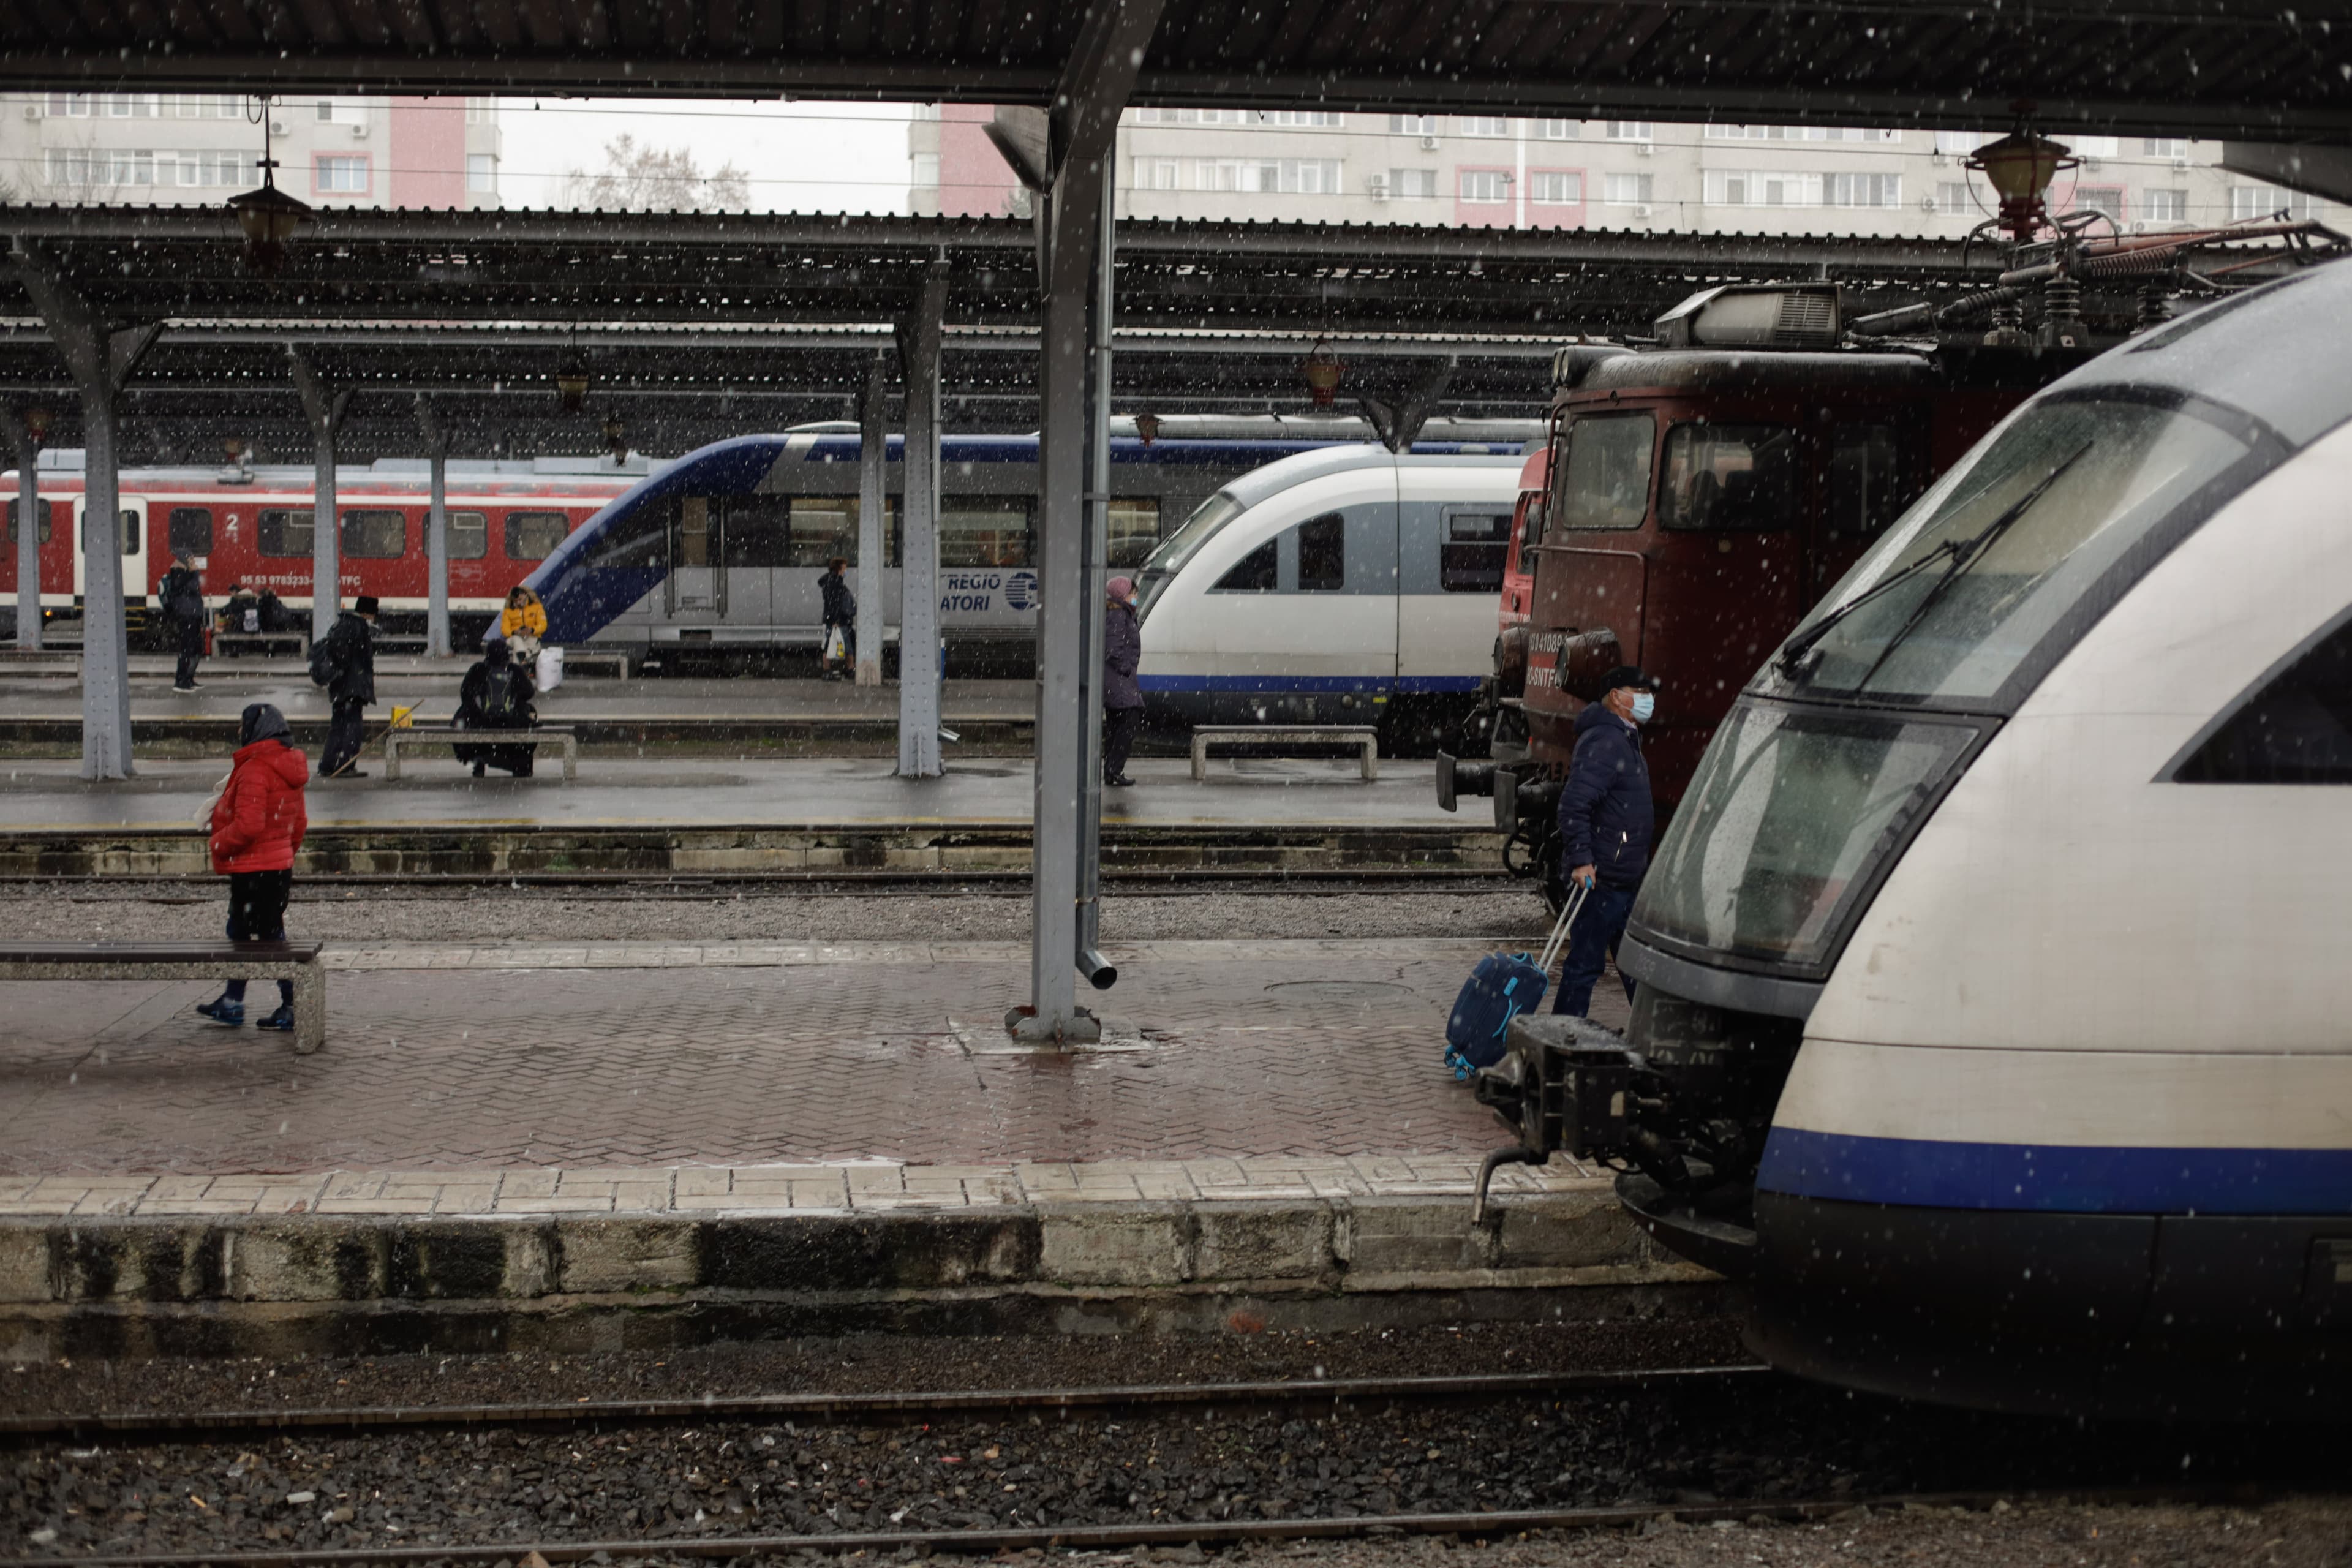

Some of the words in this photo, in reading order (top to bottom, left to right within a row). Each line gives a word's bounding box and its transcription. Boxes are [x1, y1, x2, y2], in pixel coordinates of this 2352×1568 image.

[226, 513, 238, 530] 2
[940, 574, 1001, 589] REGIO
[940, 595, 990, 611] ATORI
